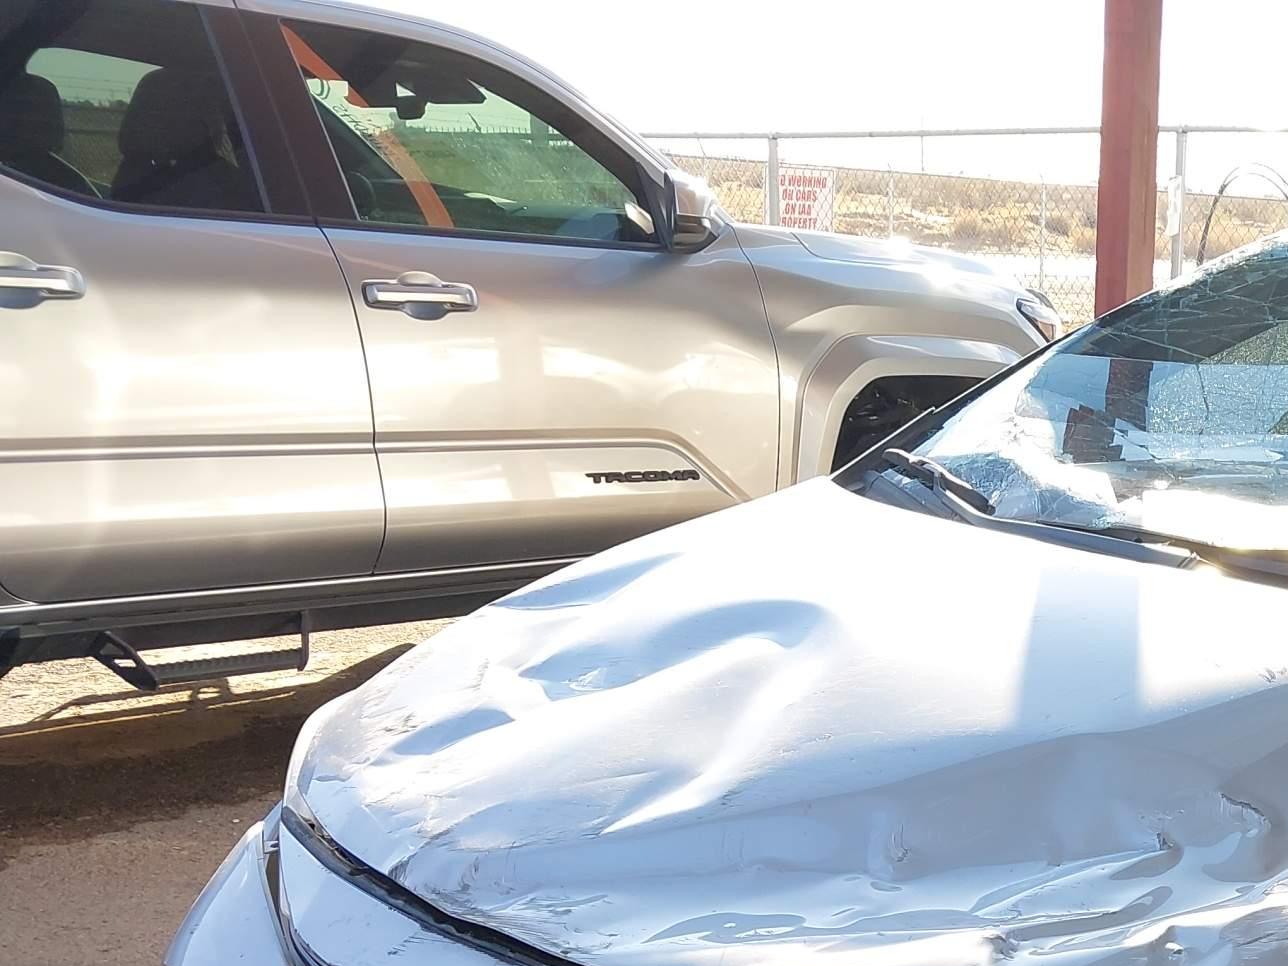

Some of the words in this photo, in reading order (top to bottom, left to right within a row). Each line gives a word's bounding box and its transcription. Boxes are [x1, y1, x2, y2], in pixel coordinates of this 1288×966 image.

[788, 175, 828, 188] WORKING
[795, 189, 818, 202] CARS
[784, 203, 796, 215] ON
[798, 203, 812, 216] IAA
[781, 216, 818, 230] ROPERTY
[585, 469, 701, 484] TACOMA
